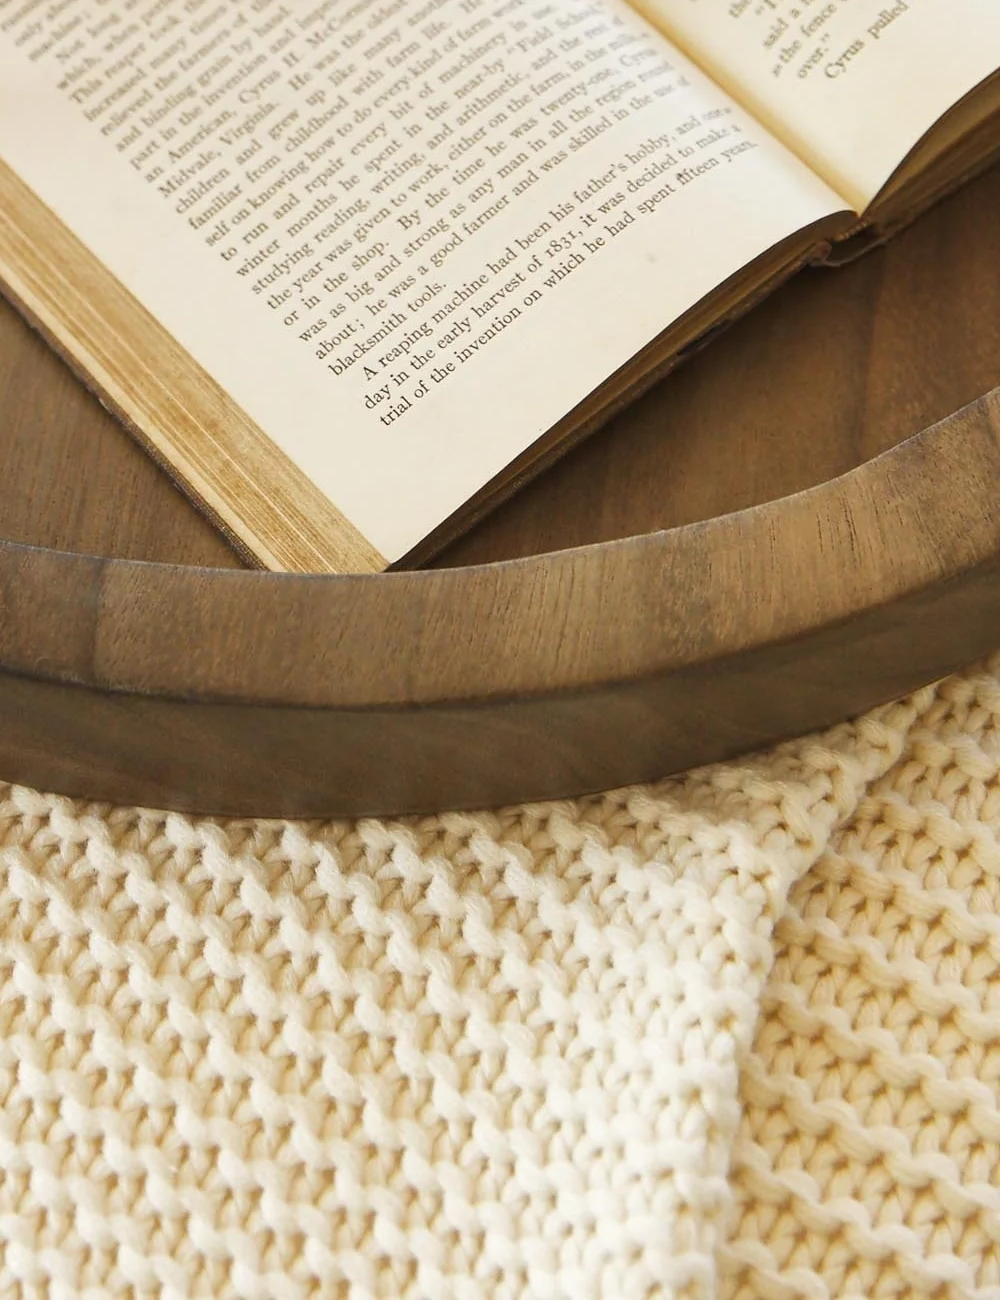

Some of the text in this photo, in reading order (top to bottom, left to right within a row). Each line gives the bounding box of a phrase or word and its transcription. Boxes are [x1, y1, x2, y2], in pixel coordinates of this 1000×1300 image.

[188, 184, 243, 230] familiar
[245, 155, 281, 184] from
[284, 95, 350, 153] childhood
[352, 69, 385, 96] with
[385, 41, 422, 69] farm
[236, 239, 280, 276] winter
[286, 194, 338, 238] months
[337, 175, 360, 191] he
[364, 139, 403, 173] spent
[402, 124, 423, 138] in
[424, 101, 450, 121] the
[453, 58, 505, 100] near-by
[251, 36, 583, 295] studying reading, writing, and arithmetic, and the
[824, 39, 865, 79] Cyrus
[205, 220, 231, 247] self
[231, 208, 251, 225] on
[246, 160, 310, 210] knowing
[304, 136, 336, 163] how
[336, 123, 354, 137] to
[353, 106, 372, 124] do
[220, 247, 238, 261] to
[242, 222, 269, 245] run
[272, 192, 301, 220] and
[304, 157, 345, 194] repair
[350, 122, 388, 156] every
[388, 100, 415, 120] bit
[267, 289, 292, 309] the
[292, 261, 324, 293] year
[324, 239, 353, 262] was
[353, 208, 392, 243] given
[390, 193, 408, 207] to
[407, 163, 449, 193] work,
[448, 126, 487, 161] either
[488, 112, 508, 128] on
[506, 94, 533, 113] the
[565, 60, 587, 72] in
[584, 47, 609, 63] the
[283, 310, 299, 326] or
[300, 295, 321, 310] in
[323, 272, 349, 293] the
[351, 242, 389, 271] shop.
[396, 210, 421, 230] By
[424, 188, 450, 208] the
[452, 158, 485, 185] time
[484, 141, 507, 157] he
[509, 117, 538, 139] was
[298, 318, 327, 342] was
[329, 303, 346, 319] as
[344, 281, 375, 302] big
[374, 254, 402, 282] and
[403, 218, 450, 258] strong
[449, 203, 467, 219] as
[468, 178, 494, 203] any
[496, 152, 529, 179] man
[527, 139, 547, 153] in
[548, 119, 569, 139] all
[568, 105, 594, 123] the
[315, 319, 365, 360] about;
[365, 299, 388, 316] he
[388, 275, 416, 298] was
[417, 265, 429, 276] a
[430, 232, 464, 268] good
[462, 195, 510, 235] farmer
[512, 169, 540, 196] and
[539, 150, 568, 172] was
[568, 115, 613, 152] skilled
[610, 108, 630, 121] in
[628, 95, 653, 111] the
[363, 115, 702, 381] A reaping machine had been his father's hobby, and
[364, 384, 391, 409] day
[390, 371, 410, 386] in
[410, 350, 436, 370] the
[437, 317, 471, 349] early
[470, 272, 526, 318] harvest
[527, 254, 543, 273] of
[544, 230, 583, 258] 1831,
[579, 214, 598, 227] it
[597, 192, 626, 214] was
[626, 153, 678, 193] decided
[677, 146, 695, 158] to
[327, 283, 447, 376] blacksmith tools.
[380, 396, 413, 426] trial
[414, 379, 430, 398] of
[430, 362, 456, 383] the
[453, 307, 523, 363] invention
[523, 290, 543, 306] on
[543, 253, 586, 288] which
[582, 237, 605, 254] he
[603, 210, 636, 237] had
[636, 184, 676, 214] spent
[676, 157, 720, 186] fifteen
